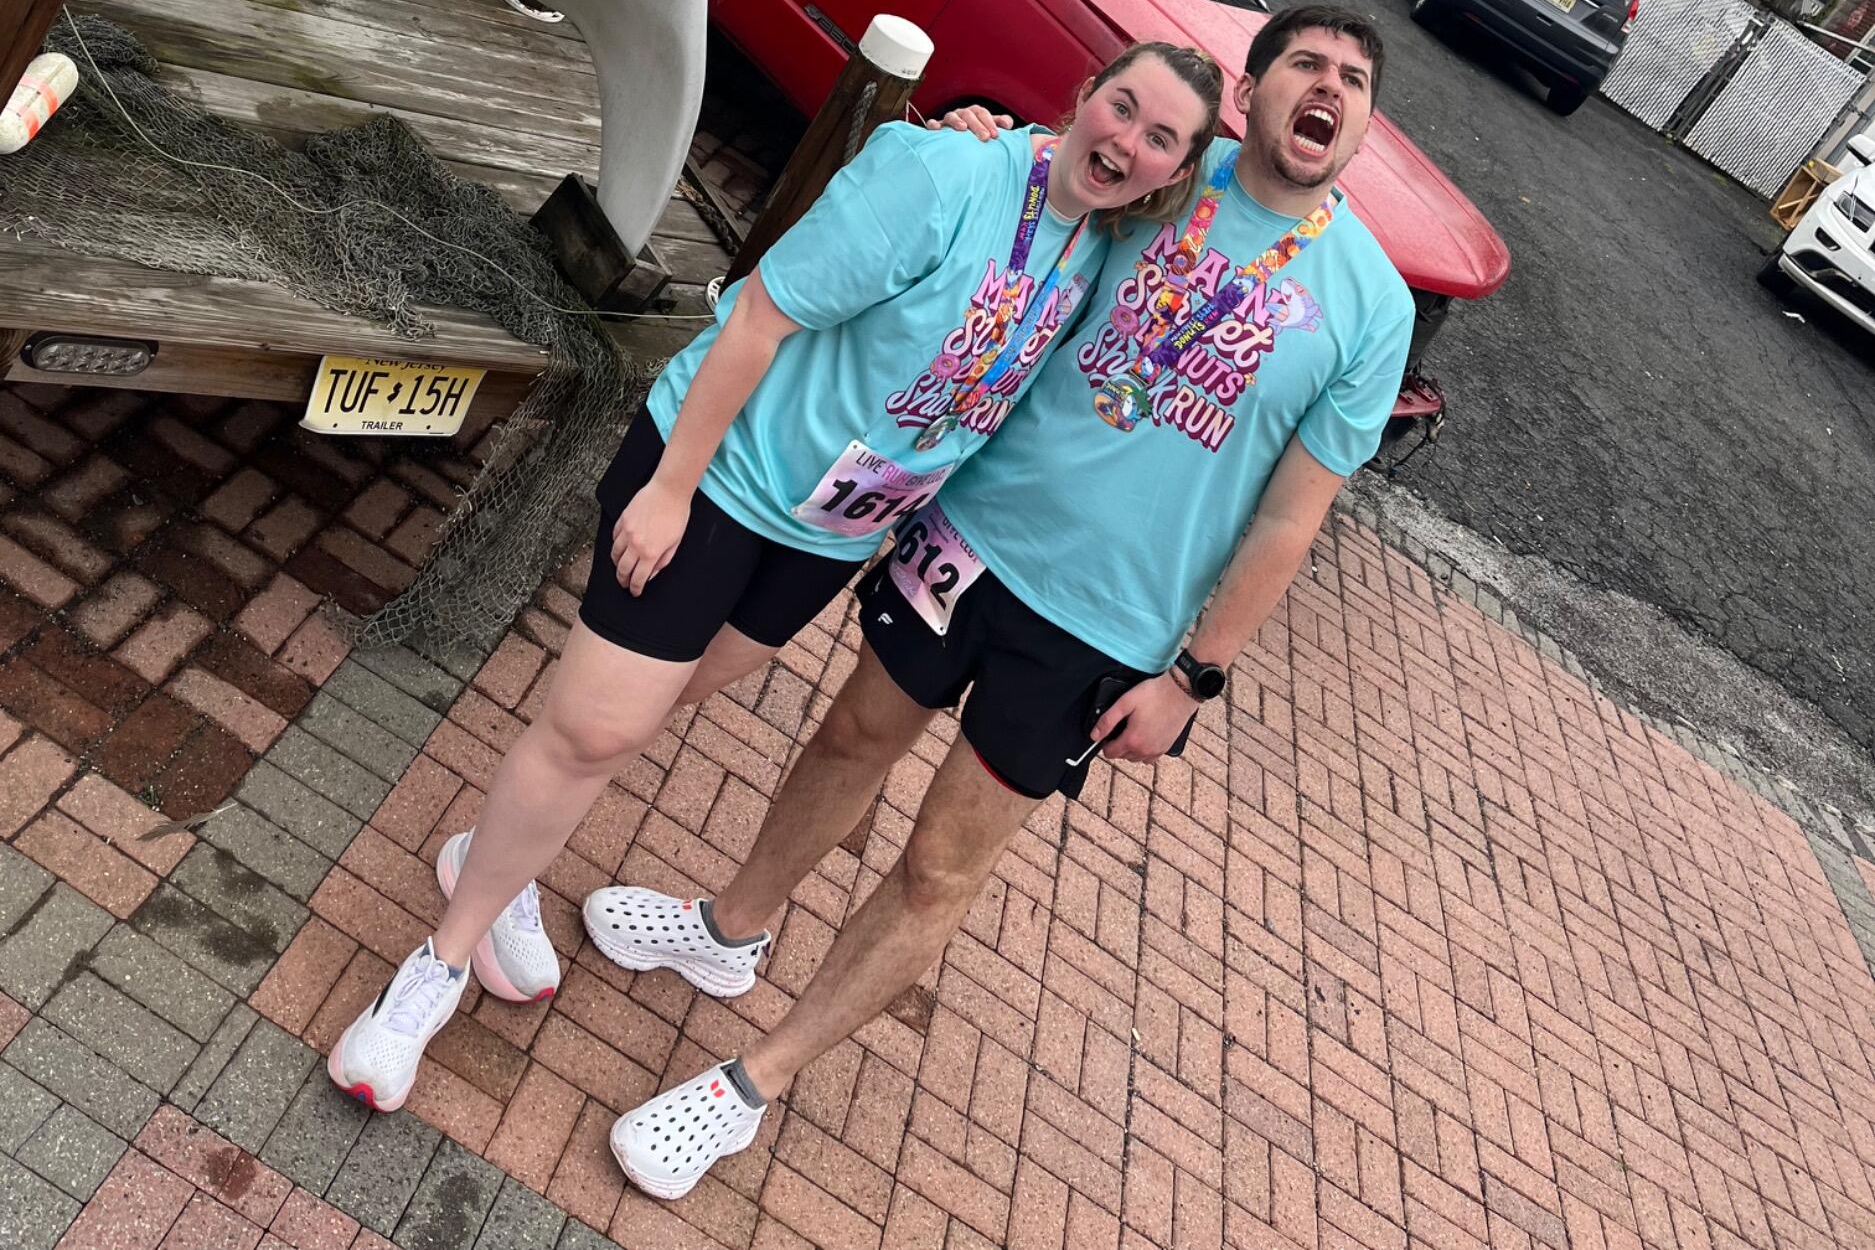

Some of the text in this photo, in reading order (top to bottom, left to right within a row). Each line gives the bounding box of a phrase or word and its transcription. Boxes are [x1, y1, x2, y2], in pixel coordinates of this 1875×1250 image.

[1141, 222, 1282, 329] MAN
[970, 258, 1062, 333] MAN
[1173, 320, 1206, 350] DONUTS
[400, 359, 448, 374] Jersey
[324, 368, 470, 417] TUF 15H
[361, 420, 404, 431] TRAILER
[959, 397, 1016, 436] RUN
[1162, 384, 1236, 454] RUN
[855, 450, 887, 475] LIVE
[881, 463, 911, 486] RUN
